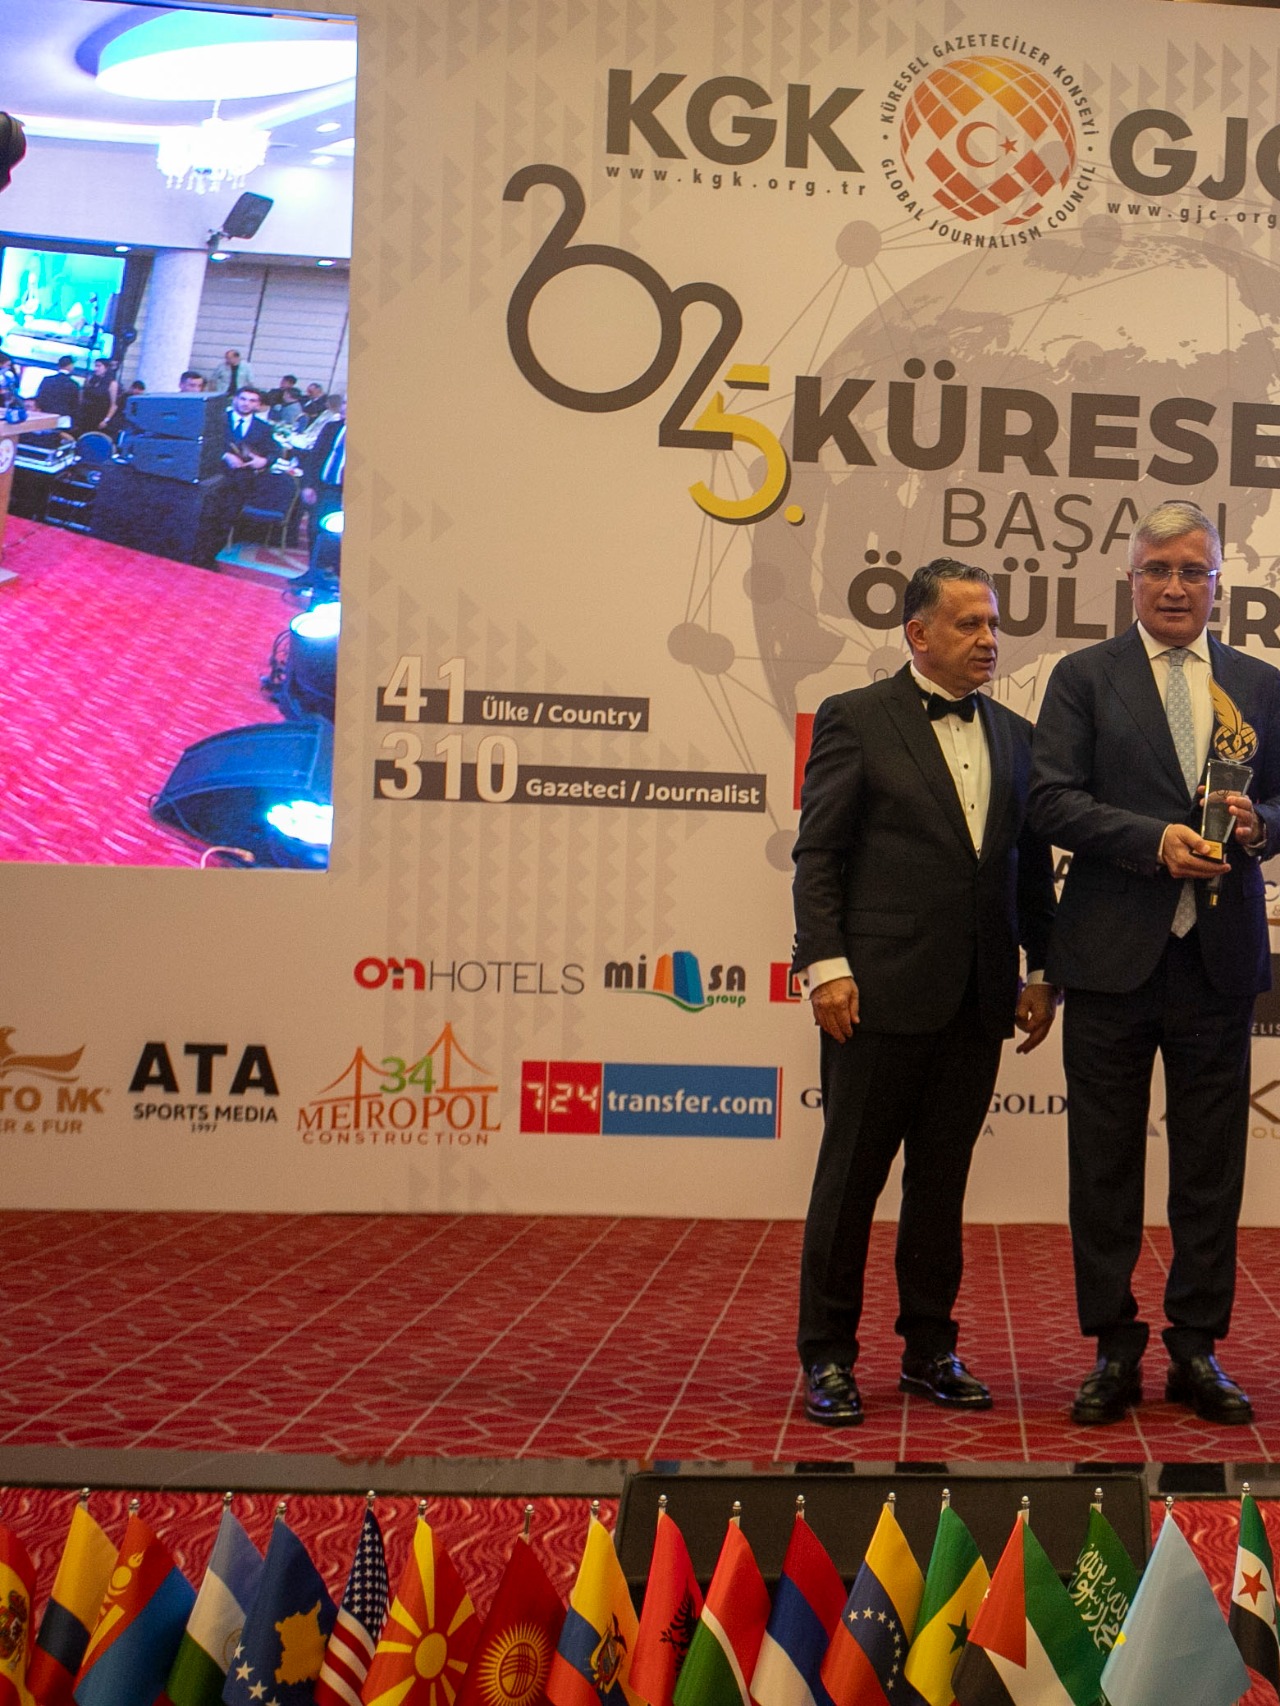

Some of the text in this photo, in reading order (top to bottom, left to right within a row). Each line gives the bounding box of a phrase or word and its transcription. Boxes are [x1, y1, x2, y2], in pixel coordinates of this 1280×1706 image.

[880, 34, 1100, 136] KÜRESEL GAZETECİLER KONSEYİ
[606, 68, 865, 173] KGK
[605, 165, 866, 197] www.kgk.org.tr
[881, 158, 1097, 249] GLOBAL JOURNALISM COUNCIL
[382, 654, 467, 724] 41
[482, 695, 529, 721] Ülke
[548, 704, 643, 730] Country
[378, 730, 519, 804] 310
[526, 777, 626, 802] Gazeteci
[644, 782, 761, 806] Journalist
[706, 994, 747, 1009] group
[127, 1041, 280, 1097] ATA
[379, 1055, 437, 1095] 34
[56, 1085, 105, 1114] MK
[133, 1102, 279, 1123] SPORTS MEDIA
[297, 1094, 501, 1132] METROPOL
[606, 1088, 774, 1115] transfer.com
[42, 1119, 82, 1134] FUR
[302, 1130, 489, 1147] CONSTRUCTION
